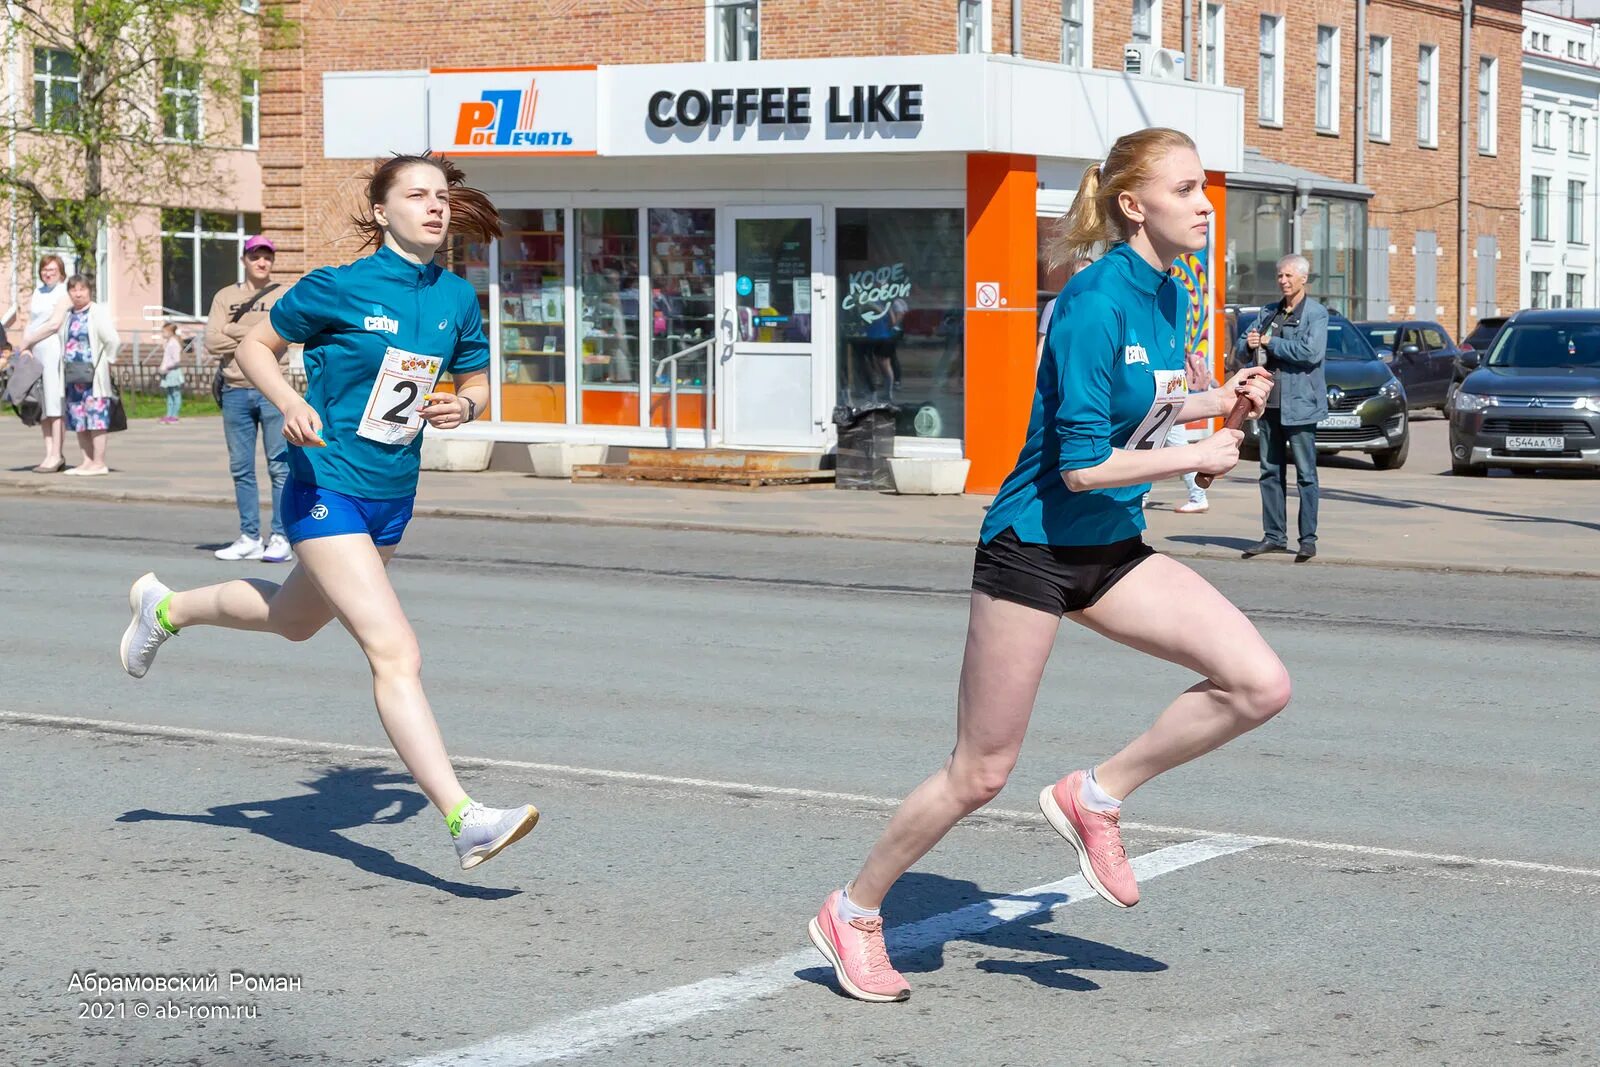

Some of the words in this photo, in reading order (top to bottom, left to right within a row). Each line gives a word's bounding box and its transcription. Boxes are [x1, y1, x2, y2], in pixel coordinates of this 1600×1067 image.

[648, 87, 812, 128] COFFEE
[829, 83, 925, 123] LIKE
[381, 380, 419, 425] 2
[1134, 403, 1174, 450] 2
